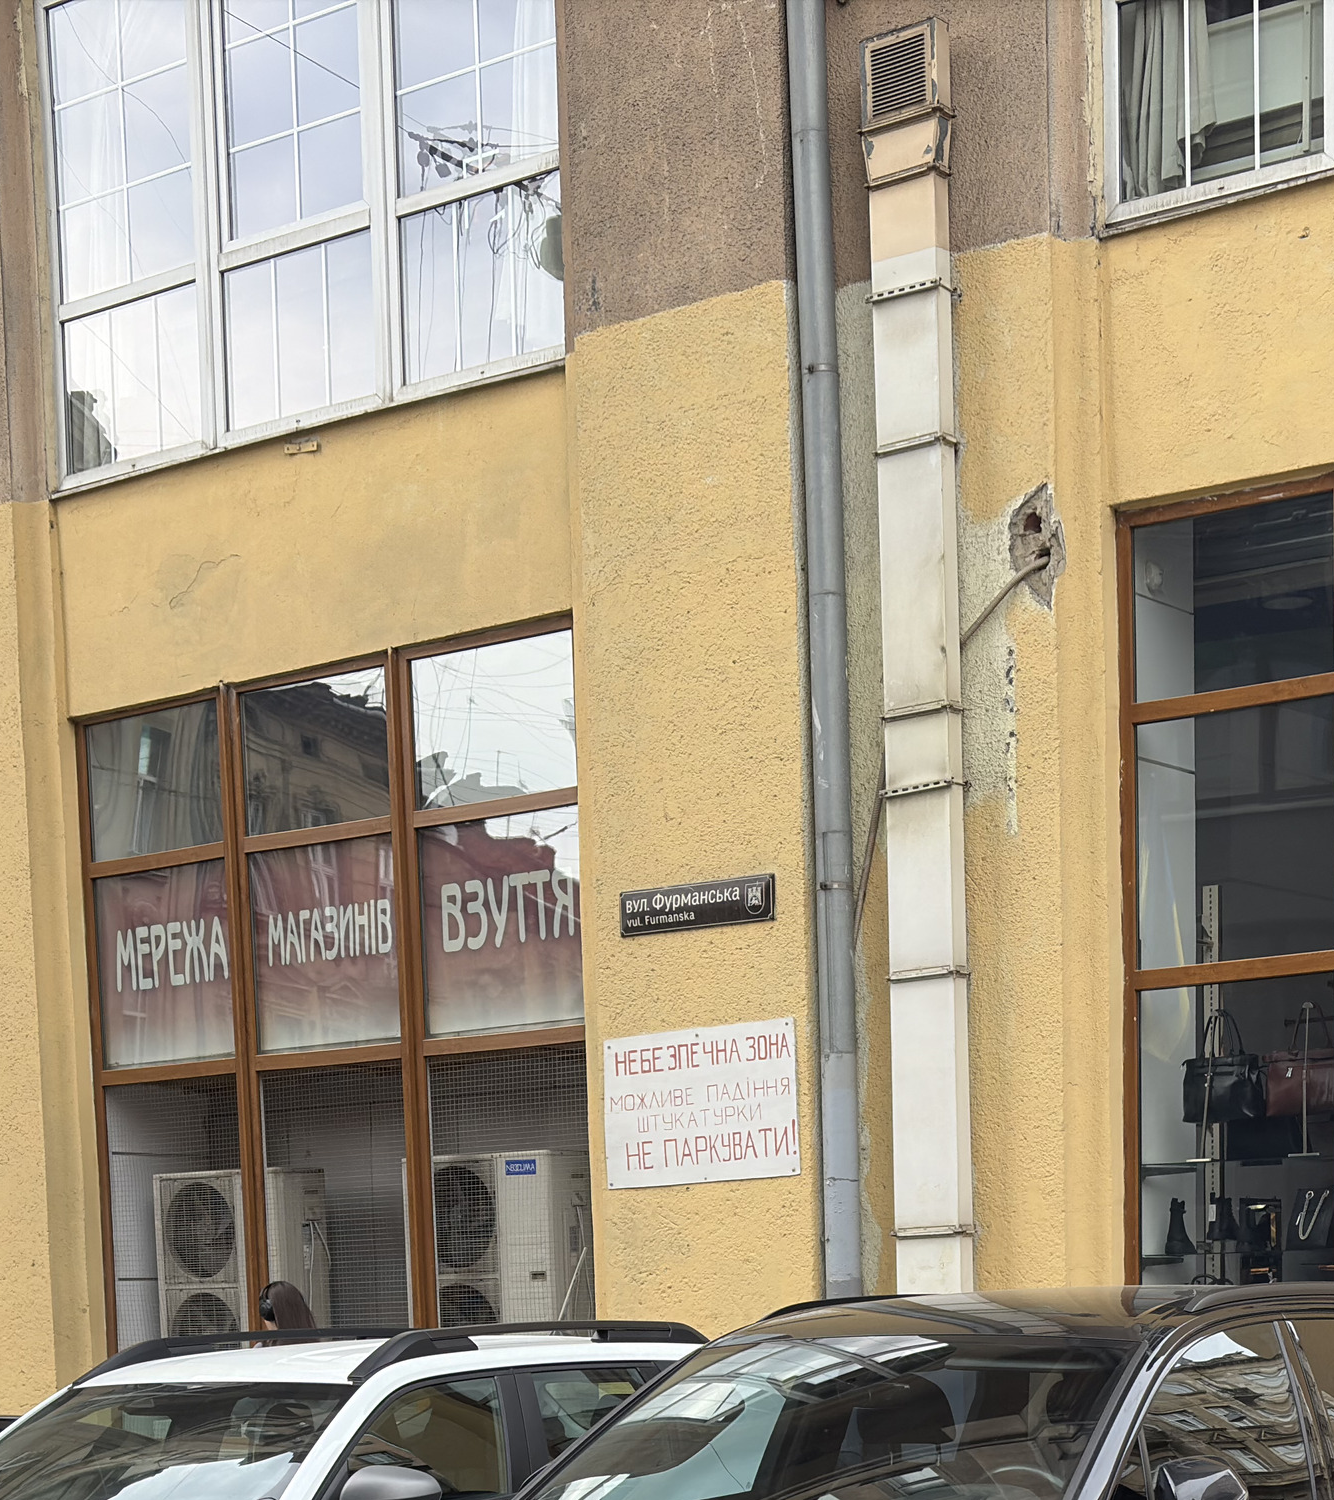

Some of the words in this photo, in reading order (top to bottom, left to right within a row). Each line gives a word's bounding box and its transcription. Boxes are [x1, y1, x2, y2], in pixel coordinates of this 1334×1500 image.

[626, 898, 650, 914] вул.
[652, 886, 740, 912] Фурманська
[116, 916, 229, 993] МЕРЕЖА
[267, 898, 393, 967] МАГАЗИНІВ
[440, 869, 576, 953] ВЗУТТЯ
[626, 915, 643, 928] vul.
[645, 910, 695, 926] Furmanska
[614, 1038, 741, 1076] НЕБЕЗПЕЧНА
[745, 1032, 791, 1062] ЗОНА
[610, 1087, 694, 1112] МОЖЛИВЕ
[637, 1102, 762, 1133] ШТУКАТУРКИ
[625, 1140, 654, 1171] НЕ
[663, 1118, 798, 1168] ПАРКУВАТИ!
